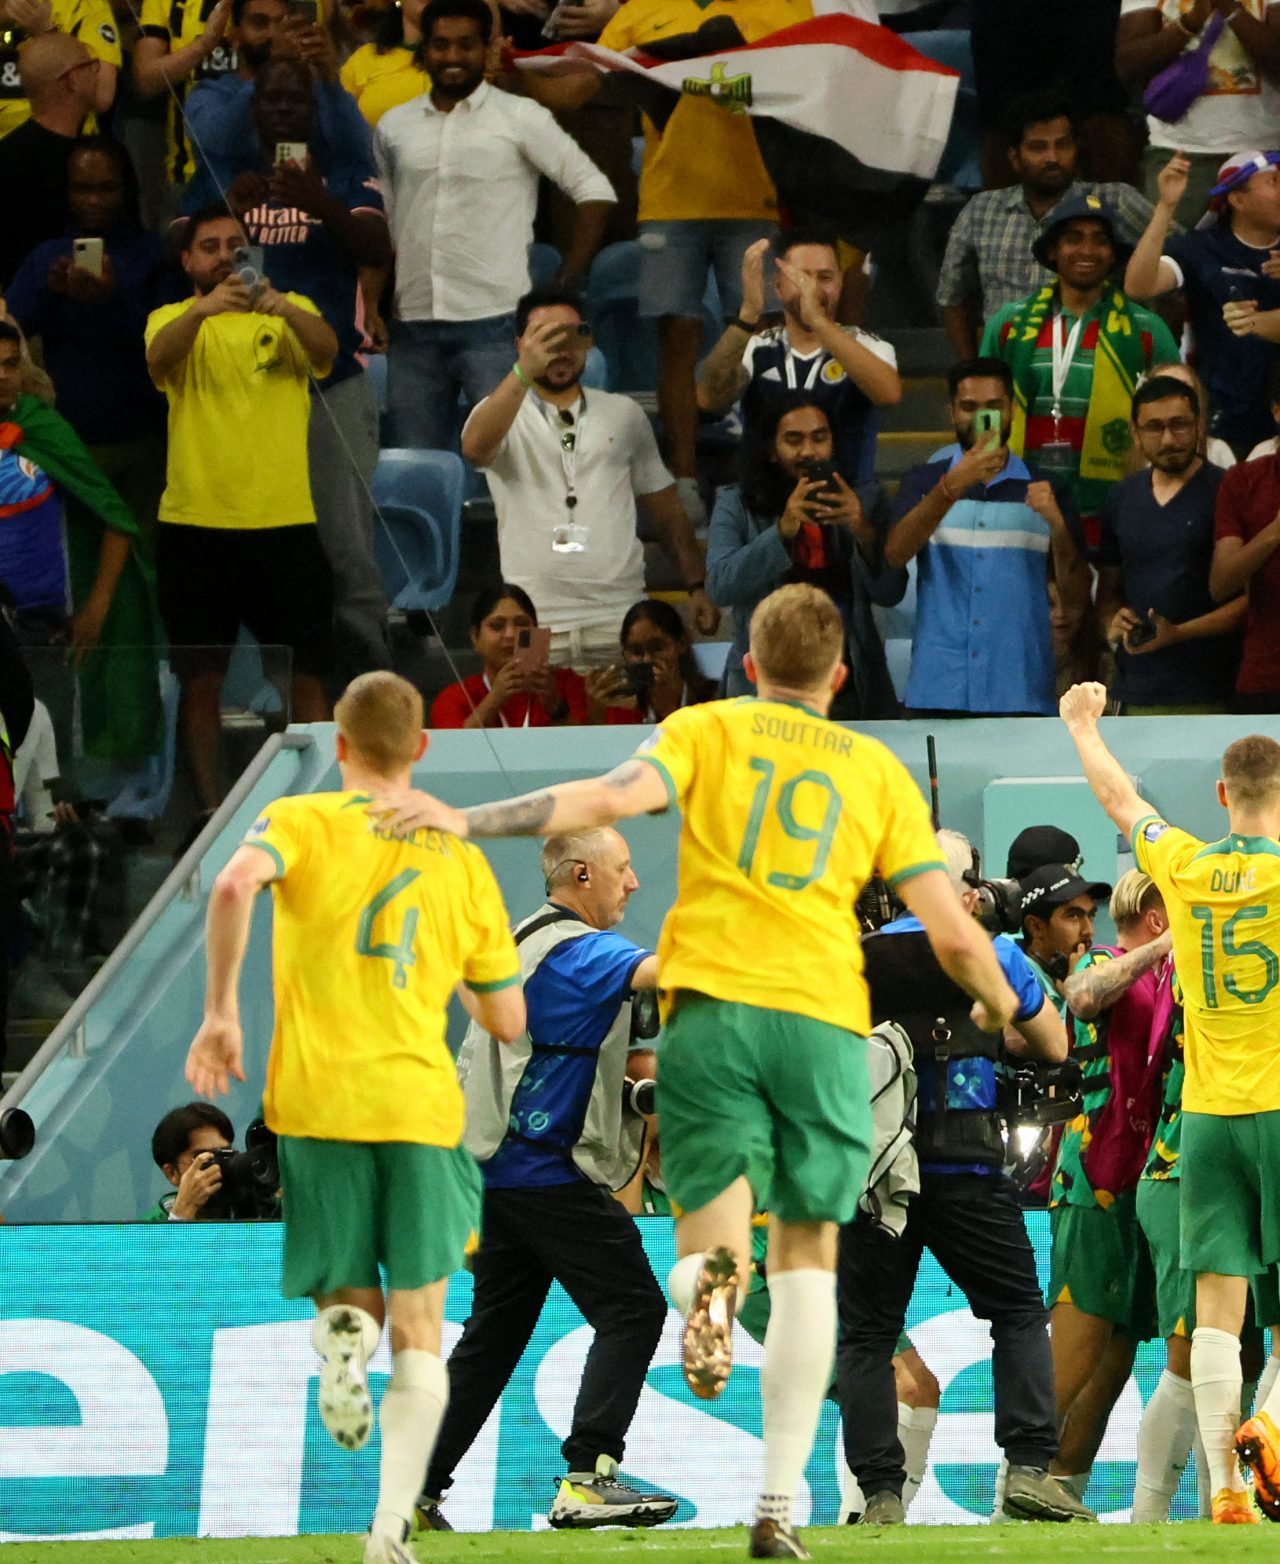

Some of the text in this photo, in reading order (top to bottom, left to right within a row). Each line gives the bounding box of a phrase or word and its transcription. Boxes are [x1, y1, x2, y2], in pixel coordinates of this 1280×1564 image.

[751, 712, 854, 759] SOUTTAR
[737, 756, 843, 892] 19
[355, 866, 423, 991] 4
[1190, 904, 1280, 1008] 15
